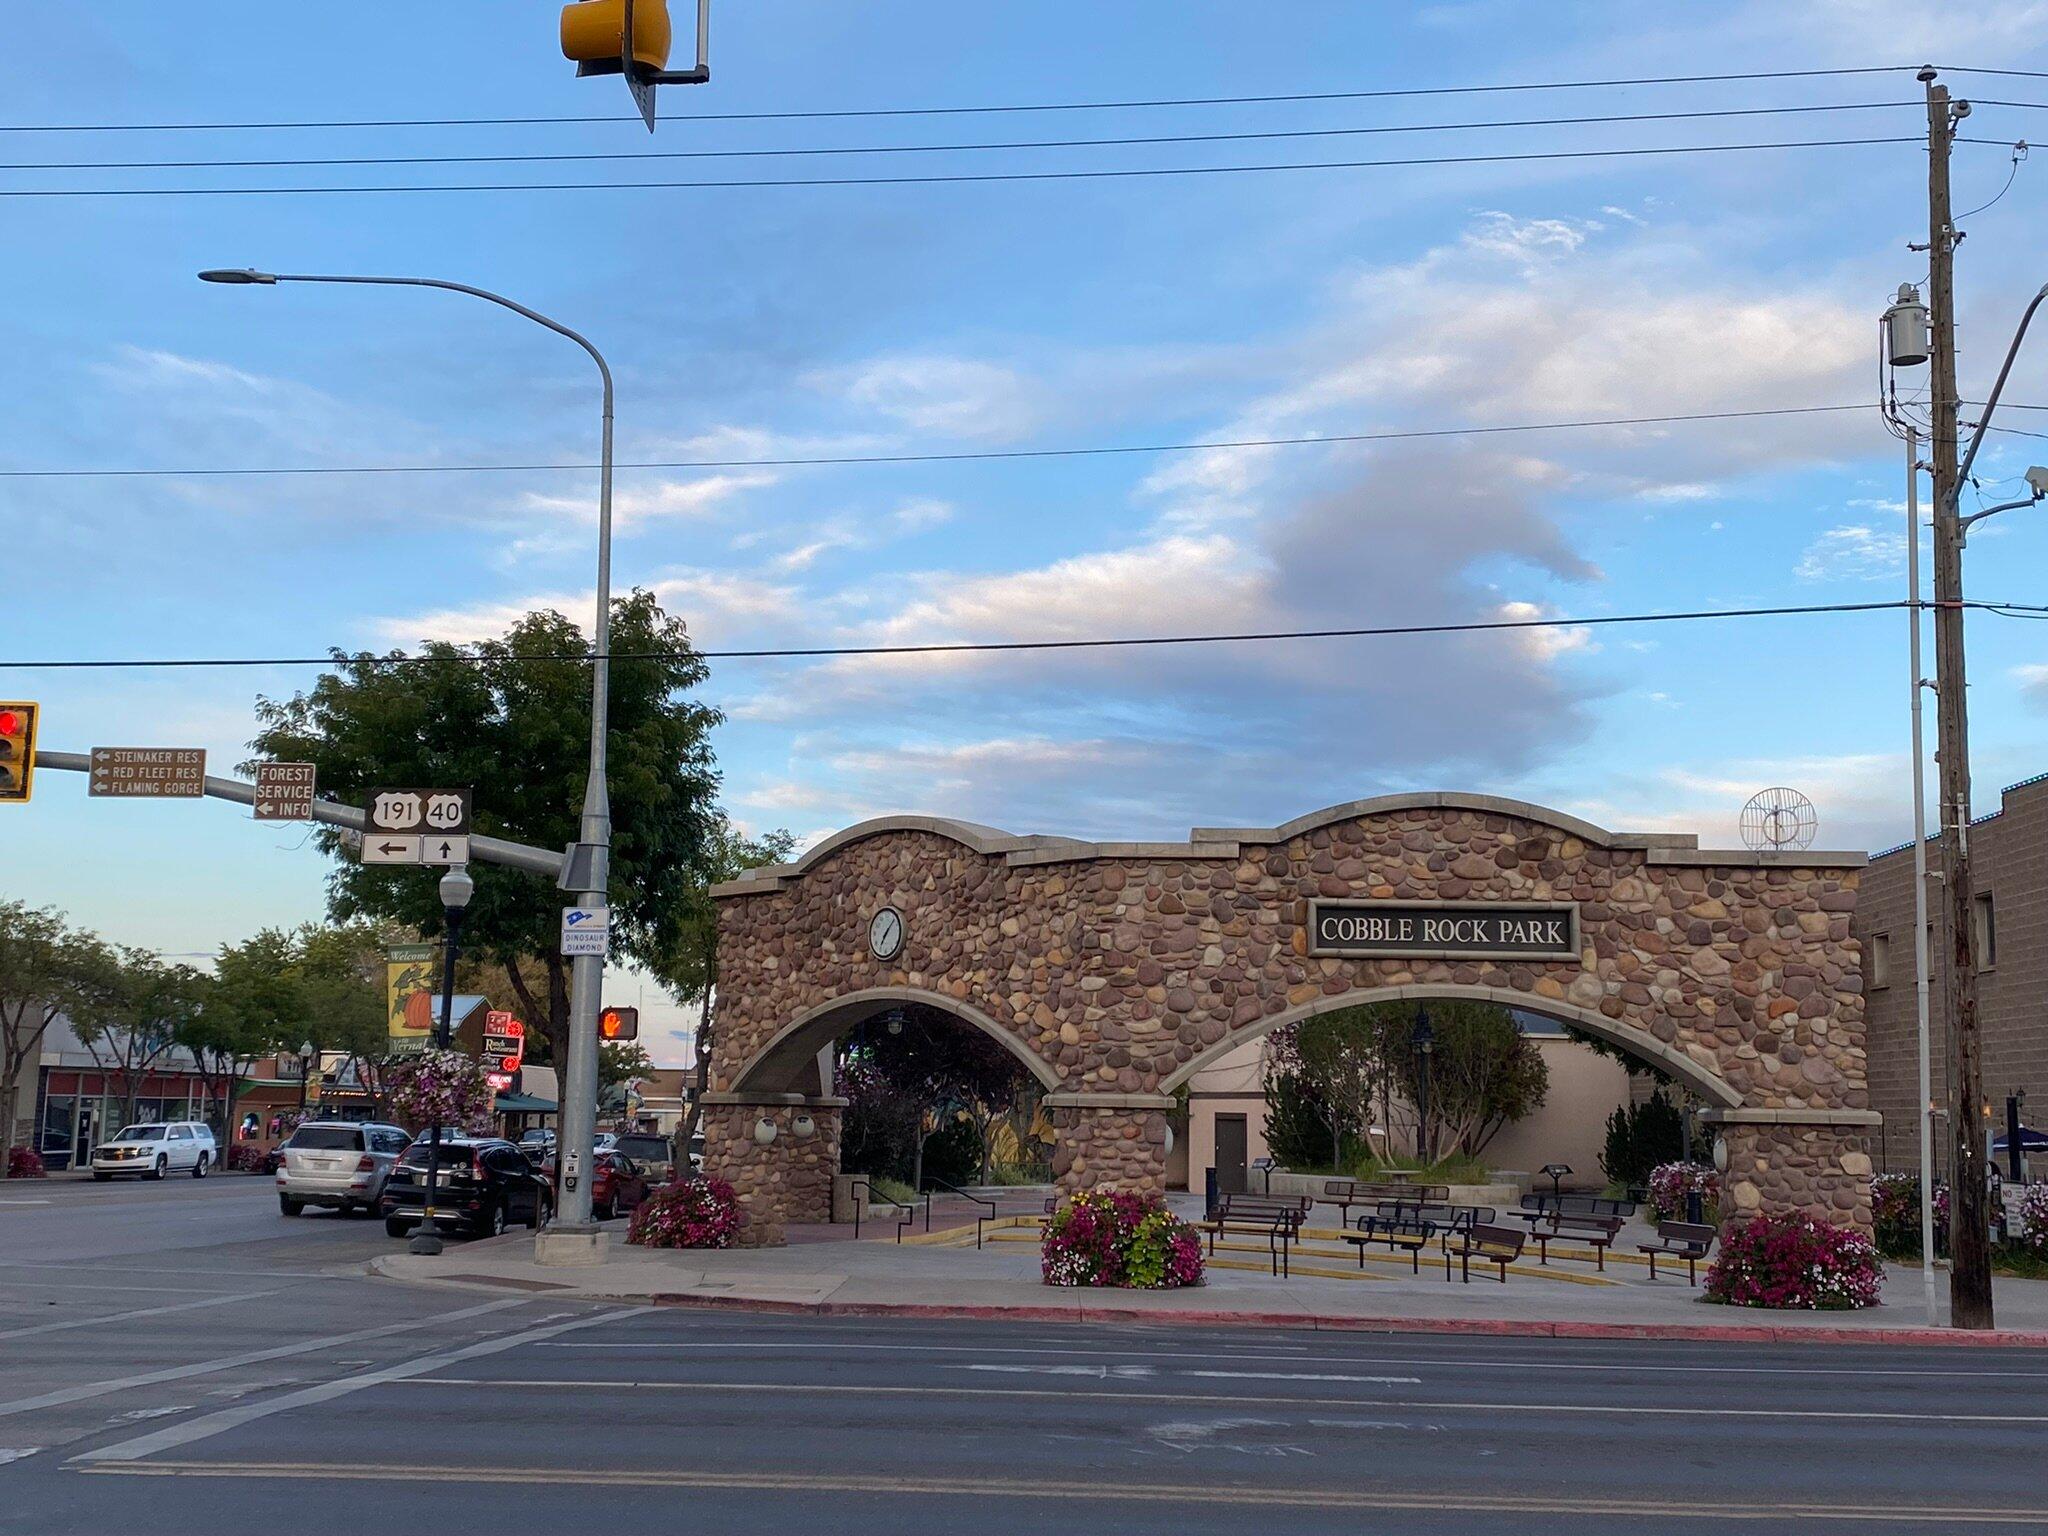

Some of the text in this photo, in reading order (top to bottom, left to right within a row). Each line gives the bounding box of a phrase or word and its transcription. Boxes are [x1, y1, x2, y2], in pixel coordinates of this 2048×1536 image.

[114, 751, 202, 764] STEINAKER RES.
[112, 766, 200, 779] RED FLEET RES.
[260, 768, 310, 781] FOREST
[111, 781, 200, 794] FLAMING GORGE
[257, 785, 311, 799] SERVICE
[279, 802, 309, 816] INFO
[383, 801, 413, 821] 191
[430, 802, 459, 821] 40
[1320, 917, 1565, 945] COBBLE ROCK PARK
[565, 934, 605, 942] DINOSAUR
[390, 950, 431, 961] Welcome
[393, 1038, 429, 1051] Vernal
